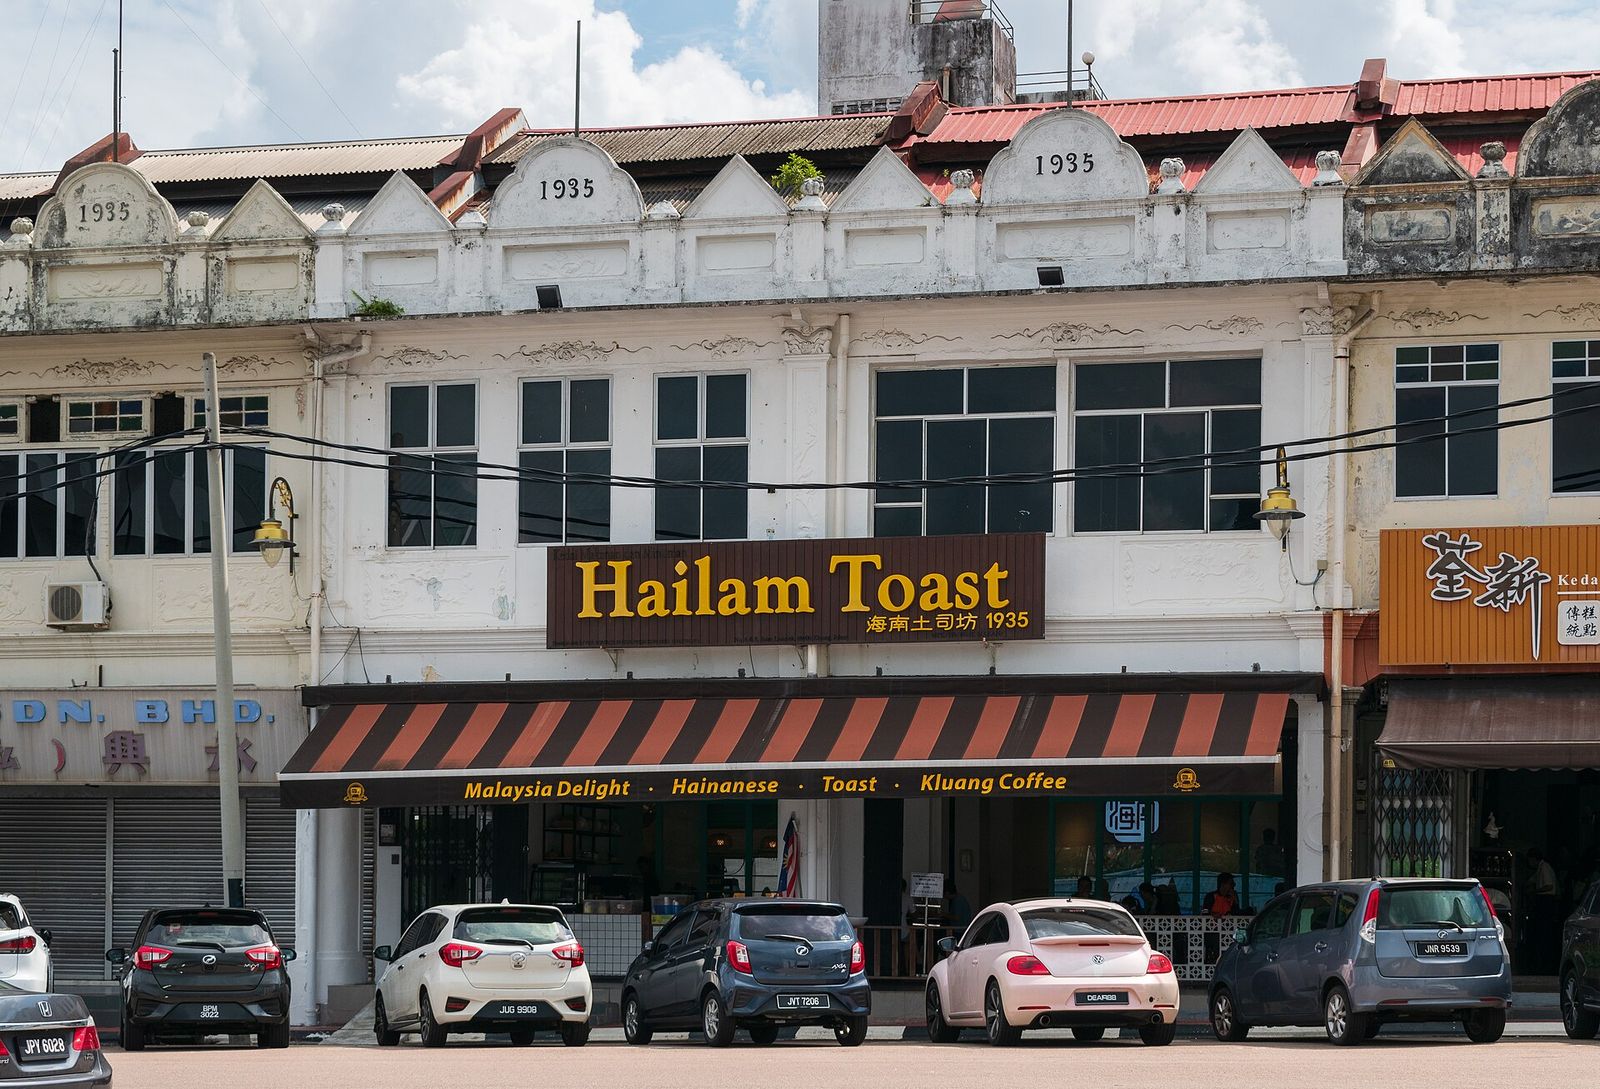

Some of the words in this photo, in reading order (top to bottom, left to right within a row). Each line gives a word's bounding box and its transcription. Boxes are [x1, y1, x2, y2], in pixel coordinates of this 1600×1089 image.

[1035, 152, 1094, 175] 1935
[539, 177, 595, 200] 1935
[79, 201, 130, 222] 1935
[575, 555, 815, 619] Hailam
[829, 554, 1010, 612] Toast
[866, 612, 979, 633] 海南土司坊
[985, 611, 1029, 629] 1935
[0, 699, 106, 723] DN.
[135, 699, 275, 723] BHD.
[464, 780, 552, 802] Malaysia
[556, 779, 631, 800] Delight
[671, 777, 779, 795] Hainanese
[822, 776, 878, 792] Toast
[920, 773, 994, 794] Kluang
[999, 772, 1067, 790] Coffee
[1424, 944, 1439, 953] JNR
[1440, 944, 1460, 953] 9539
[499, 1005, 515, 1014] JUG
[787, 997, 800, 1006] JVT
[24, 1039, 41, 1055] JPY
[42, 1037, 65, 1053] 6028
